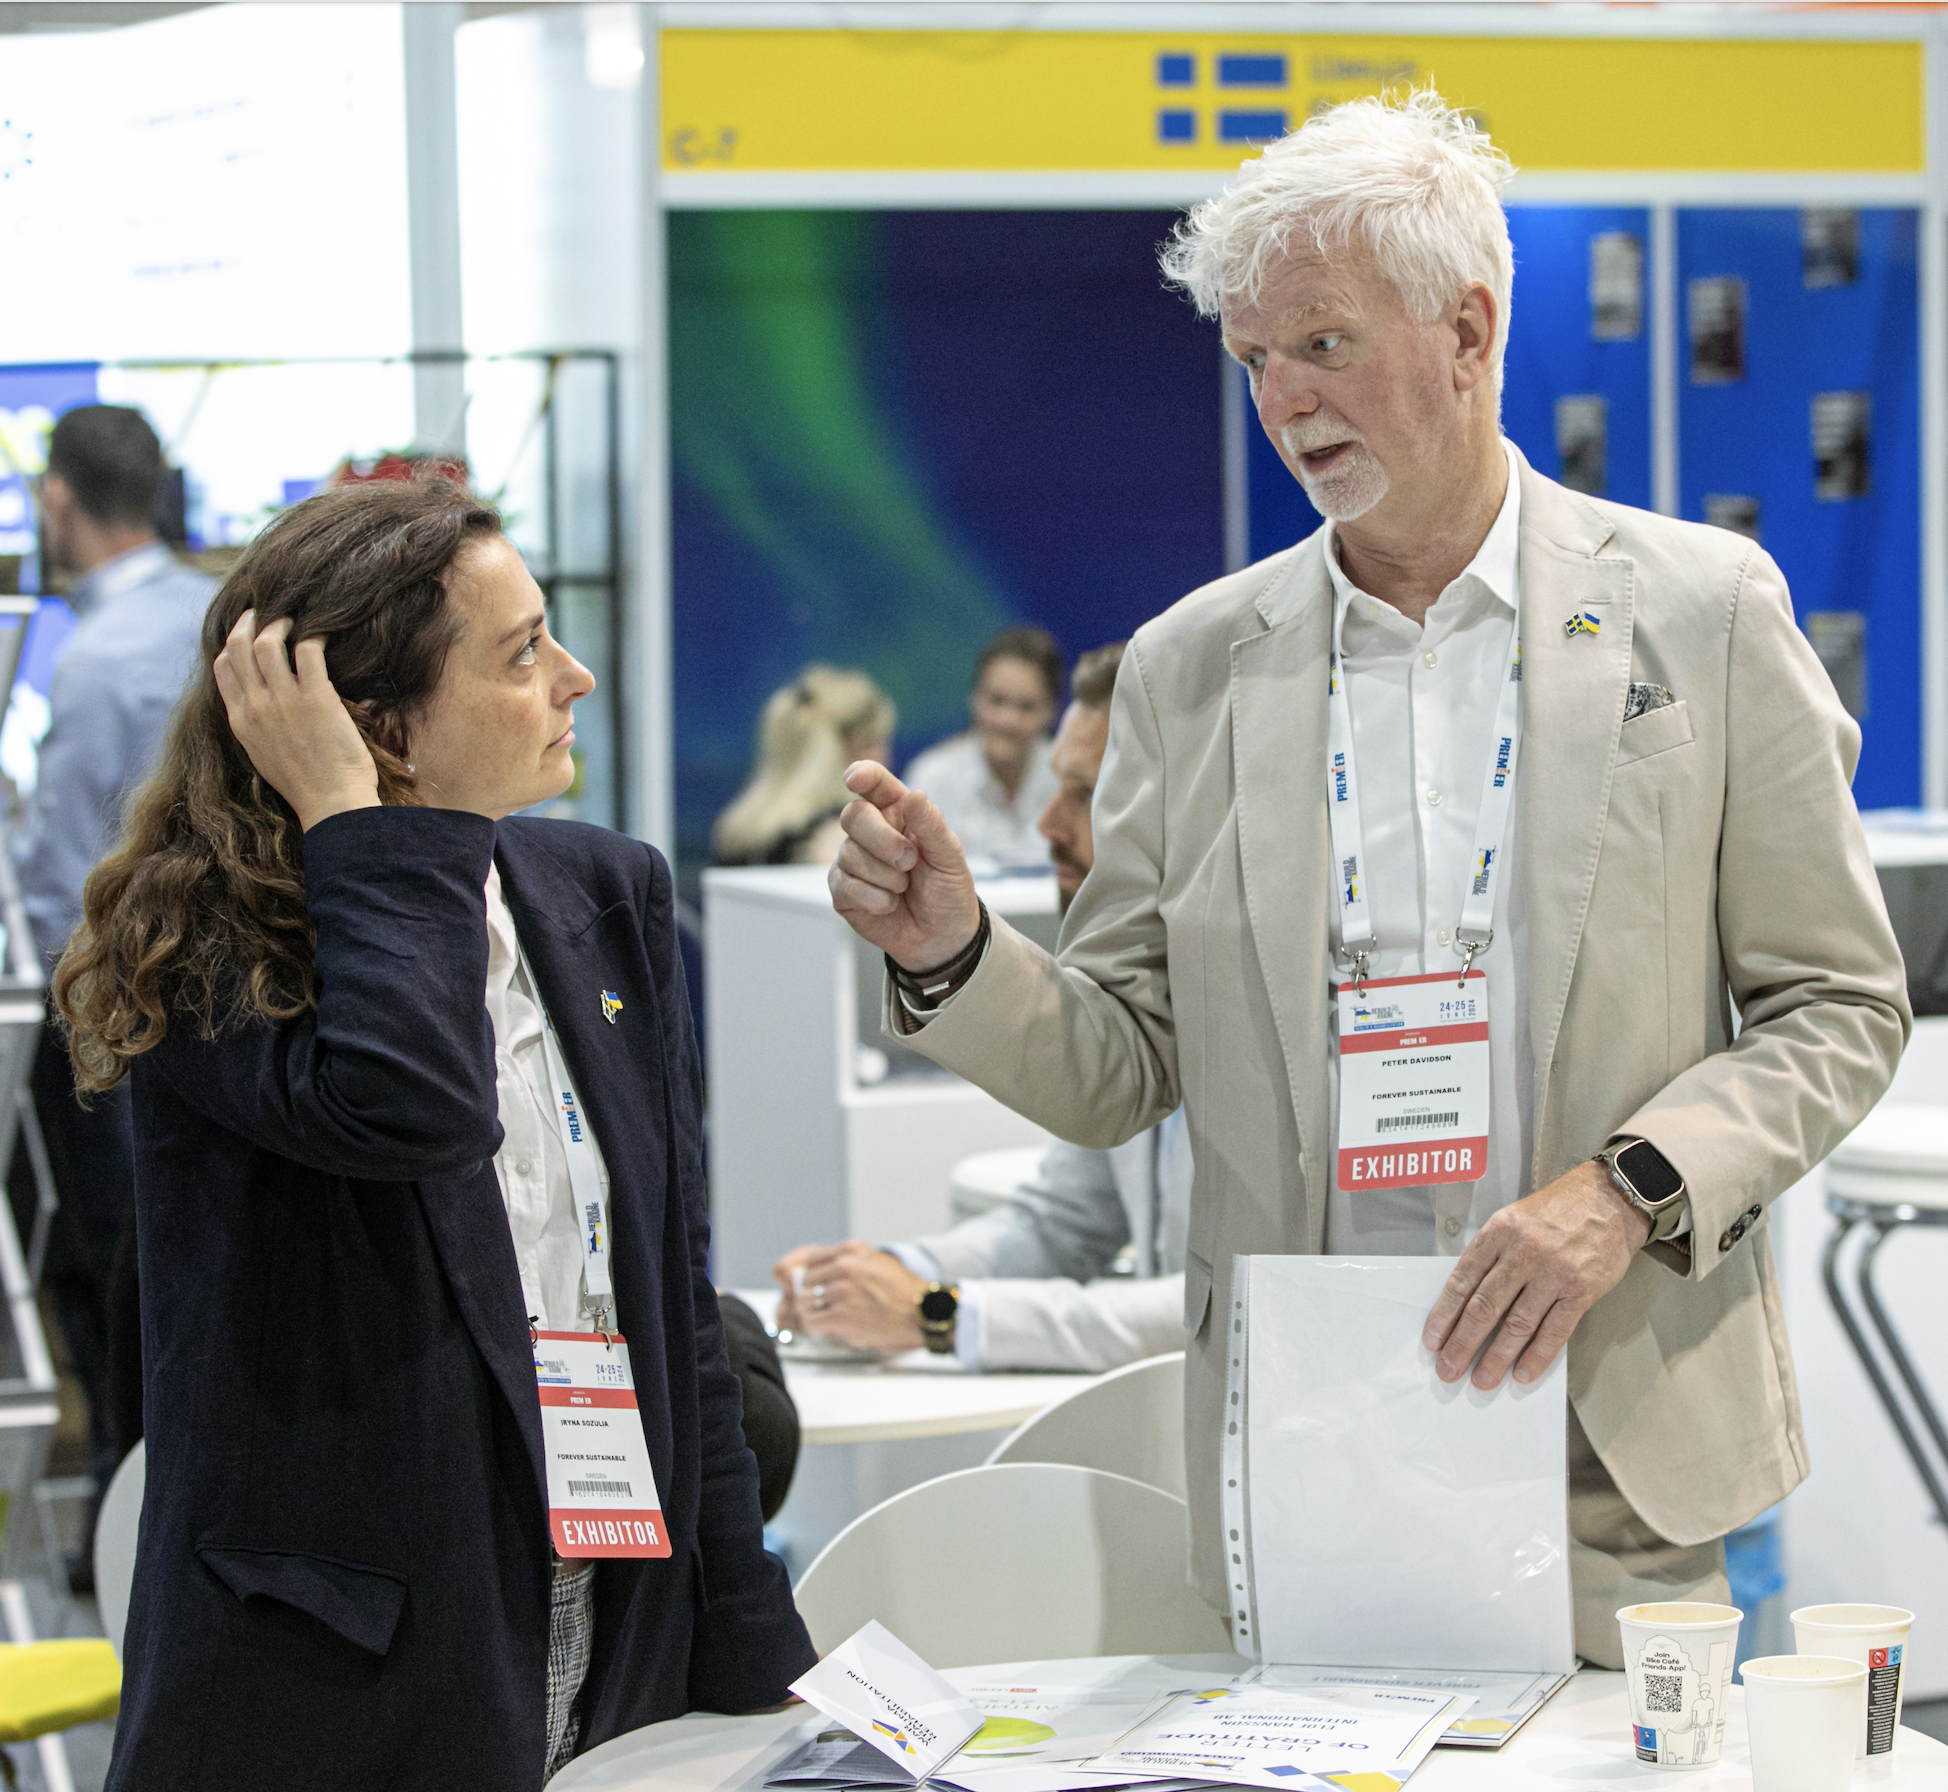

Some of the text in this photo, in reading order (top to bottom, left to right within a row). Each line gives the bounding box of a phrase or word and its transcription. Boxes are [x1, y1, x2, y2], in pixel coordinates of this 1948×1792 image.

[1343, 860, 1351, 884] REBUILD
[1350, 855, 1358, 880] UKRAINE
[1472, 872, 1482, 896] UKRAINE
[1480, 869, 1490, 894] REBUILD
[1371, 1005, 1392, 1014] REBUILD
[1440, 1001, 1466, 1012] 24-25
[1400, 1037, 1427, 1046] PREMER
[1382, 1055, 1452, 1067] PETER DAVIDSON
[1372, 1086, 1462, 1100] FOREVER SUSTAINABLE
[1352, 1148, 1472, 1180] EXHIBITOR
[586, 1205, 596, 1232] REBUILD
[592, 1202, 602, 1228] UKRAINE
[596, 1364, 616, 1374] 24-25
[562, 1520, 659, 1545] EXHIBITOR
[1642, 1662, 1666, 1670] Friends
[1311, 1676, 1411, 1686] SUSTAINABLE
[846, 1670, 937, 1740] REHABILITATION
[888, 1704, 932, 1743] TRAUMA
[1242, 1714, 1358, 1724] INTERNATIONAL
[904, 1725, 928, 1746] WAR
[1155, 1734, 1369, 1750] OF GRATITUDE
[1200, 1740, 1312, 1752] LETTER
